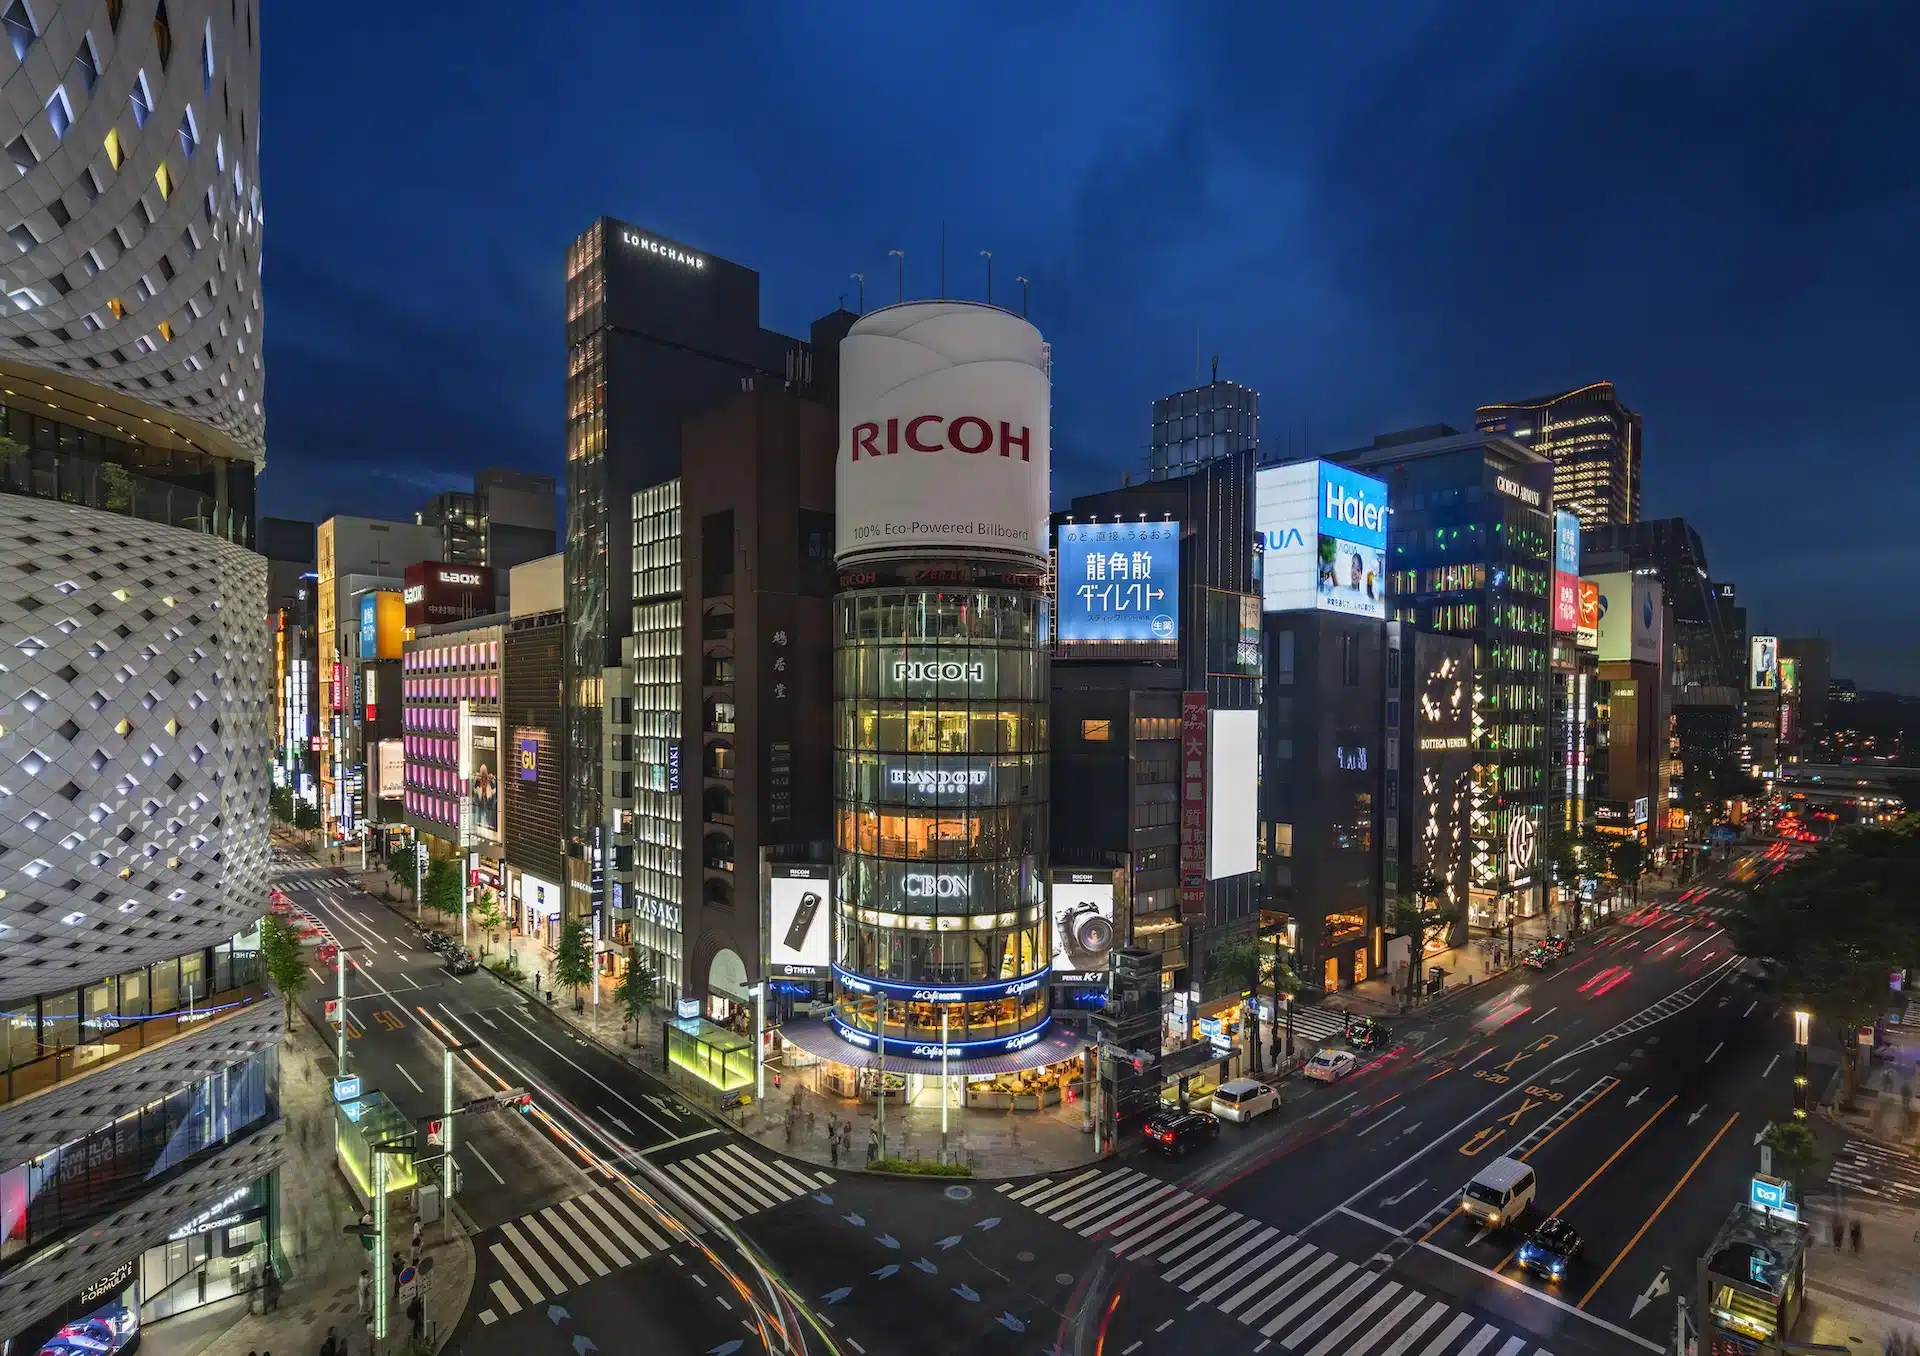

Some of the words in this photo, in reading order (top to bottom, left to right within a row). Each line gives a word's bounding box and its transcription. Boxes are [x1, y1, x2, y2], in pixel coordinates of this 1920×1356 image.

[624, 232, 703, 269] LONGCHAMP
[852, 415, 1030, 462] RICOH
[1326, 480, 1386, 532] Haier
[854, 524, 880, 540] 100%
[885, 521, 973, 535] Eco-Powered
[978, 523, 1028, 541] Billboard
[1264, 528, 1304, 550] UA
[1086, 551, 1153, 581] 龍角散
[840, 571, 876, 586] RICOH
[1076, 584, 1165, 611] ダイレクト
[772, 630, 788, 699] 鳩居堂
[894, 662, 984, 682] RICOH
[1184, 704, 1206, 714] ブランド
[1421, 738, 1446, 749] BOTTEGA
[1447, 737, 1467, 748] VENETA
[521, 750, 536, 770] GU
[670, 746, 679, 791] TASAKI
[891, 769, 950, 784] BRAND
[952, 770, 987, 784] OFF
[918, 784, 966, 793] TOKYO
[902, 874, 972, 897] CBON
[1190, 892, 1204, 900] B1F
[635, 894, 679, 924] TASAKI
[1083, 973, 1103, 981] K-1
[372, 1010, 406, 1032] 50
[198, 1213, 245, 1233] CROSSING
[81, 1272, 127, 1304] FORMULA
[127, 1266, 132, 1276] E
